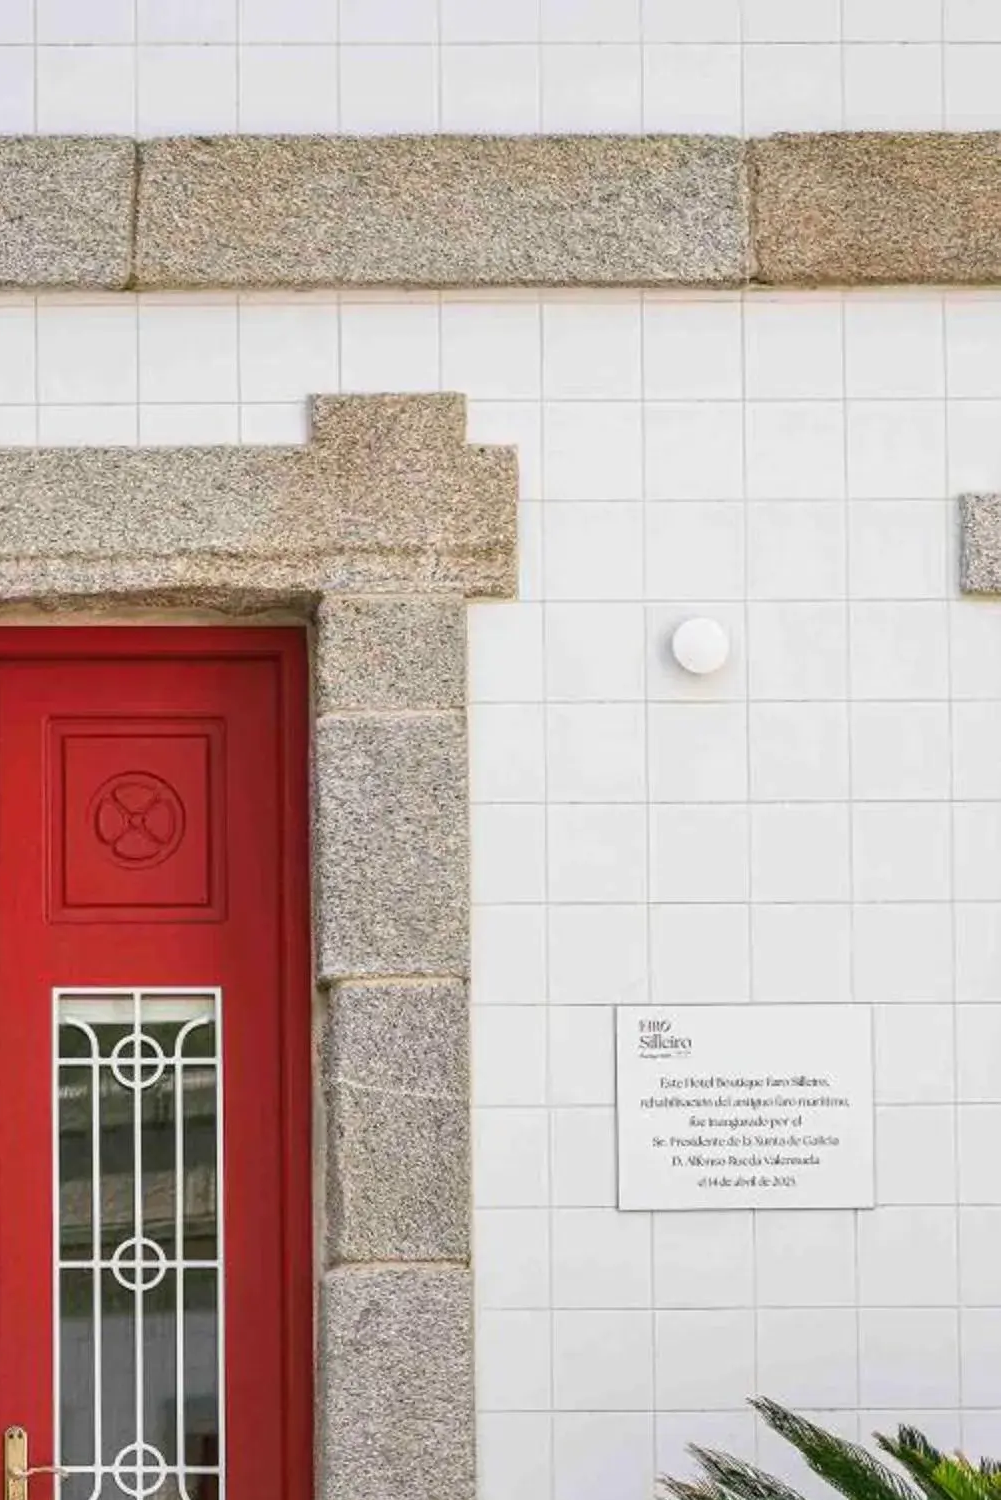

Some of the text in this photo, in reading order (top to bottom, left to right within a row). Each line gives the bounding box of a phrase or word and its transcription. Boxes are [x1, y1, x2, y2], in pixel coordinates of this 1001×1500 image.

[639, 1033, 692, 1049] Silleiro
[660, 1077, 683, 1089] Este
[684, 1076, 713, 1089] Hotel
[716, 1076, 763, 1091] Boutique
[766, 1077, 789, 1088] Faro
[714, 1096, 731, 1107] del
[732, 1098, 773, 1110] antiguo
[774, 1095, 797, 1107] faro
[689, 1115, 802, 1130] fue inaugurado por el
[669, 1135, 725, 1147] Presidente
[726, 1135, 741, 1147] de
[742, 1135, 752, 1147] la
[753, 1135, 785, 1147] Xunta
[786, 1135, 801, 1147] de
[802, 1134, 839, 1147] Galicia
[686, 1154, 726, 1167] Alfonso
[728, 1154, 762, 1167] Rueda
[718, 1175, 732, 1187] de
[733, 1175, 756, 1187] abril
[757, 1176, 771, 1187] de
